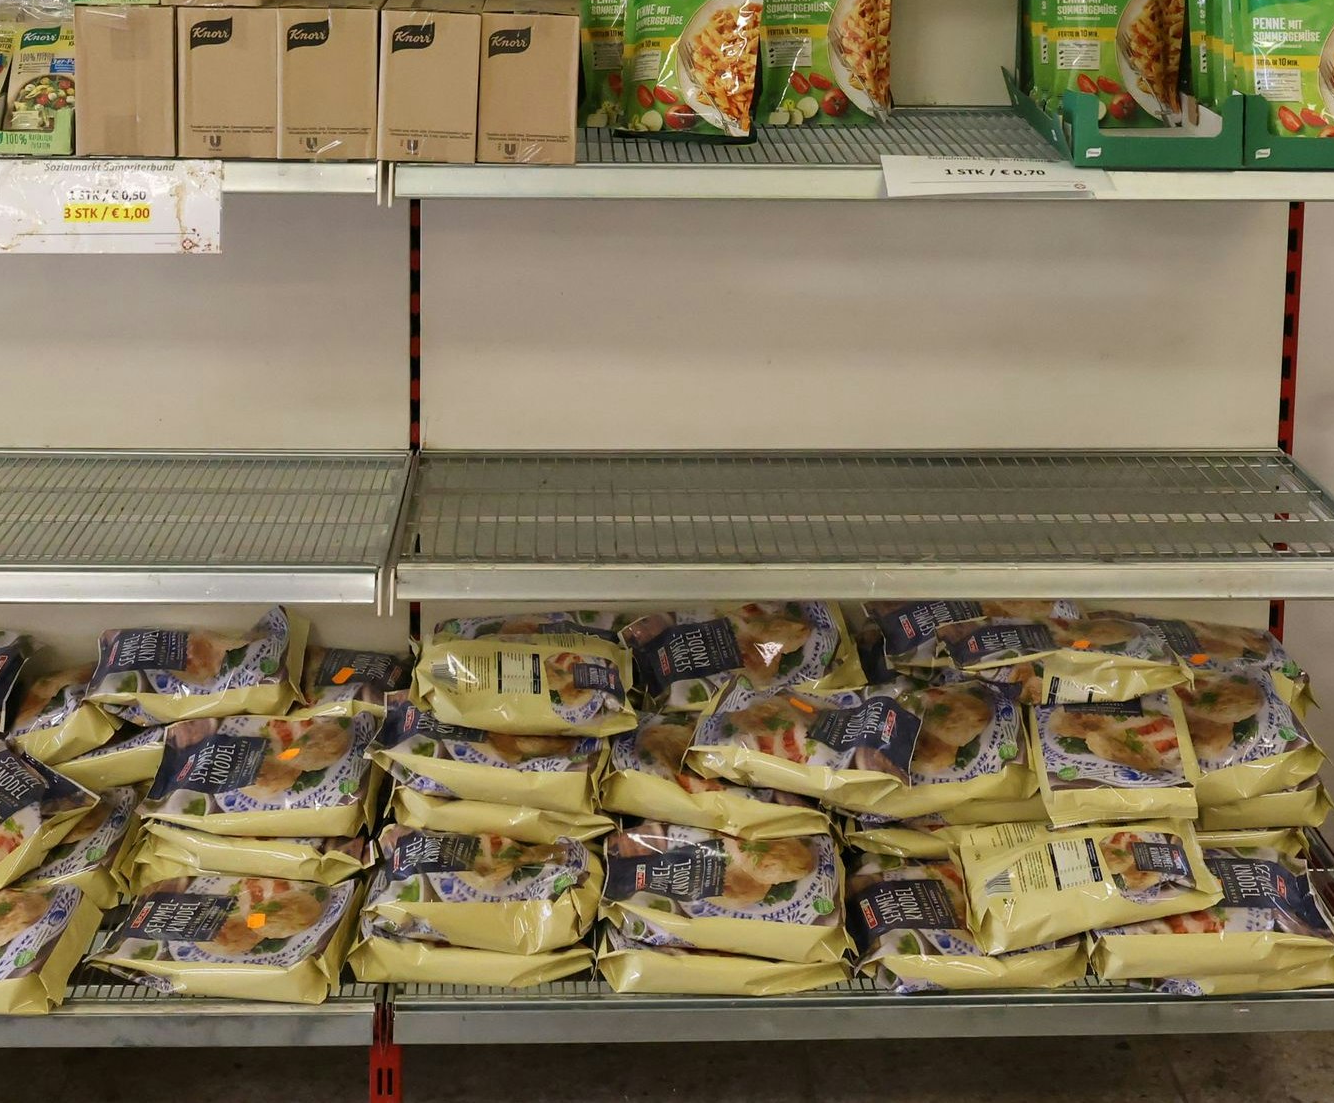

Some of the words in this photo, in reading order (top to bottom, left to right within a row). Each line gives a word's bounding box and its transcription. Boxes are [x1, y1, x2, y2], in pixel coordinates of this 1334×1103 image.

[767, 1, 829, 14] SOMMERGEMÜSE
[1057, 4, 1118, 16] SOMMERGEMÜSE
[1253, 17, 1286, 30] PENNE
[1288, 20, 1303, 30] MIT
[193, 27, 229, 39] Knorr
[395, 31, 431, 43] Knorr
[1253, 29, 1321, 43] SOMMERGEMÜSE
[490, 35, 527, 48] Knorr
[45, 163, 101, 171] Sozialmarkt
[989, 169, 996, 177] /
[1013, 169, 1046, 177] 0,70
[121, 191, 147, 202] 0,50
[64, 208, 71, 219] 3
[75, 207, 98, 219] STK
[101, 207, 107, 221] /
[111, 208, 119, 219] €
[123, 208, 150, 221] 1,00
